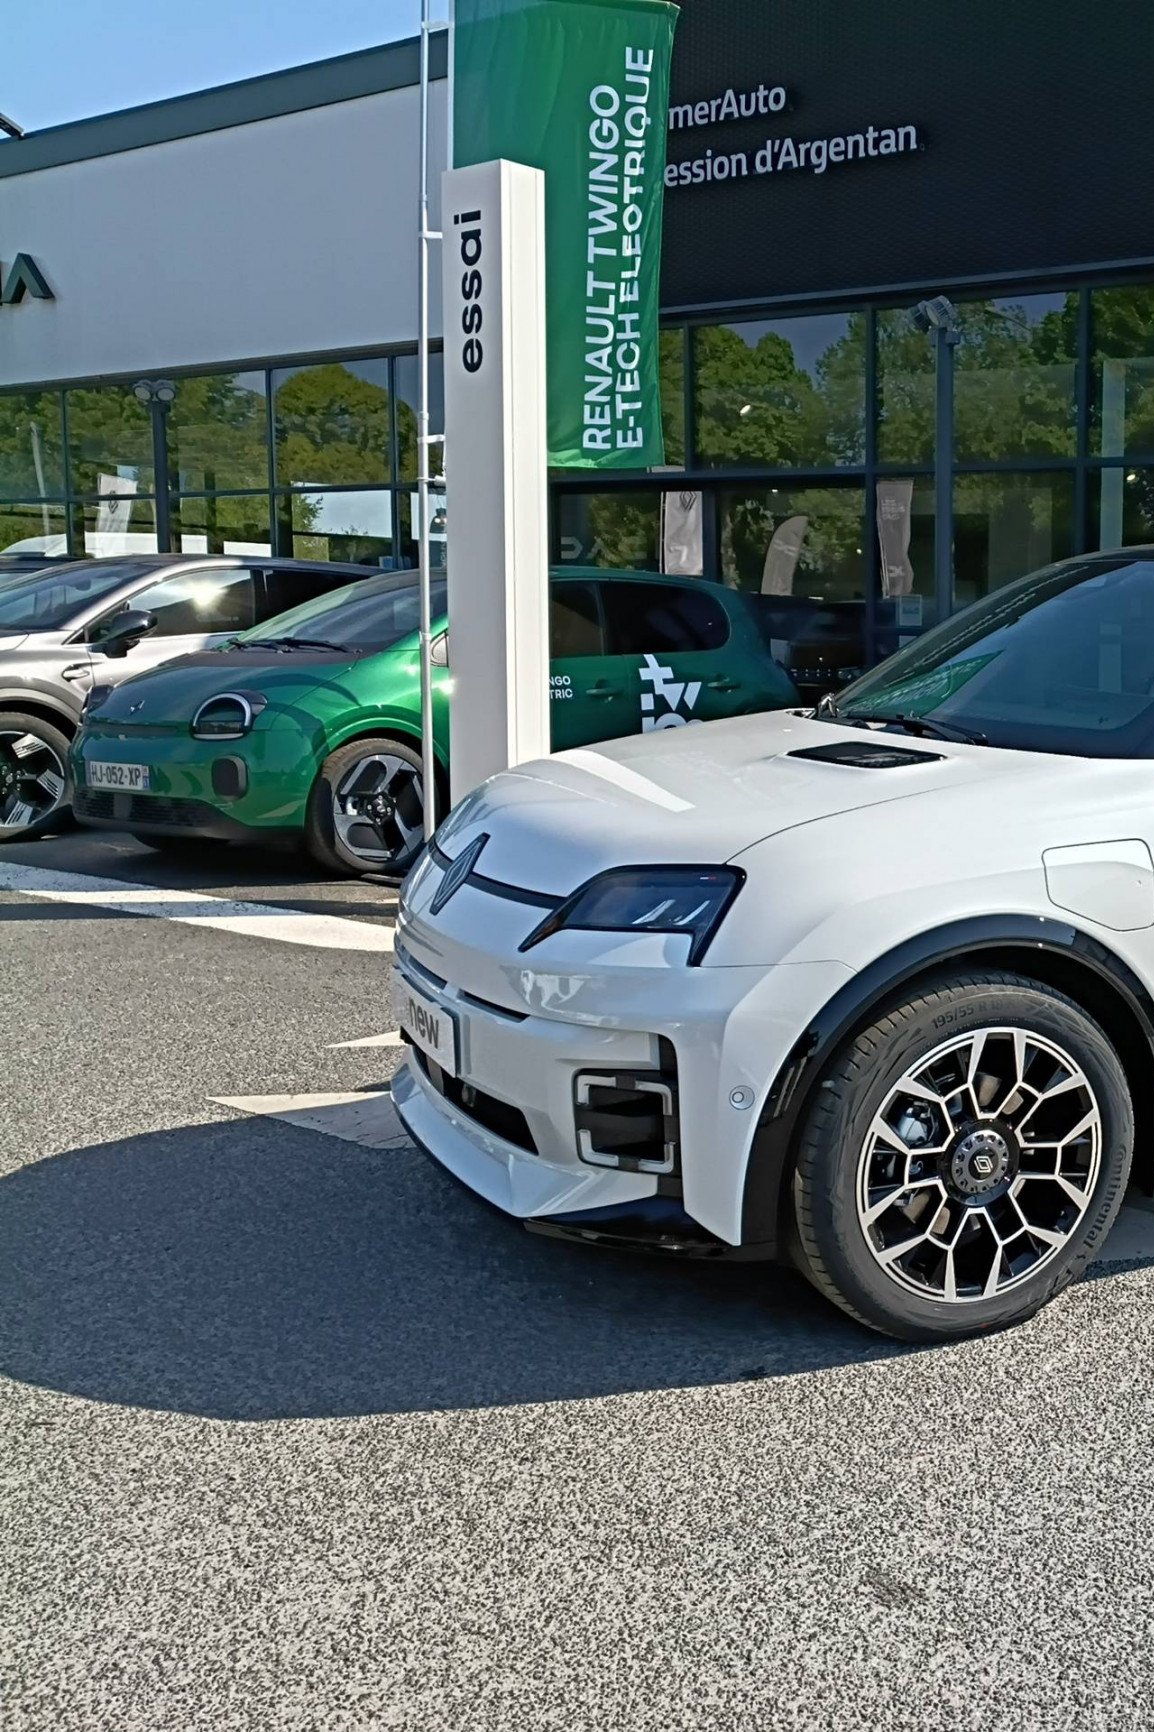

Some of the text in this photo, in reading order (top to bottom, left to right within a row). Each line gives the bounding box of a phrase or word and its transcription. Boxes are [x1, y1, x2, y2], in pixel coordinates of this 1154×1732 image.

[668, 84, 787, 130] merAuto
[664, 124, 918, 187] ession d'Argentan
[453, 209, 484, 373] essai
[582, 84, 620, 449] RENAULT TWINGO
[615, 312, 643, 448] E-TECH
[549, 675, 571, 687] NGO
[549, 688, 574, 700] TRIC
[90, 764, 142, 786] HJ-052-XP
[408, 997, 439, 1050] new
[930, 1003, 975, 1030] 195/55
[1082, 1143, 1127, 1249] Continental
